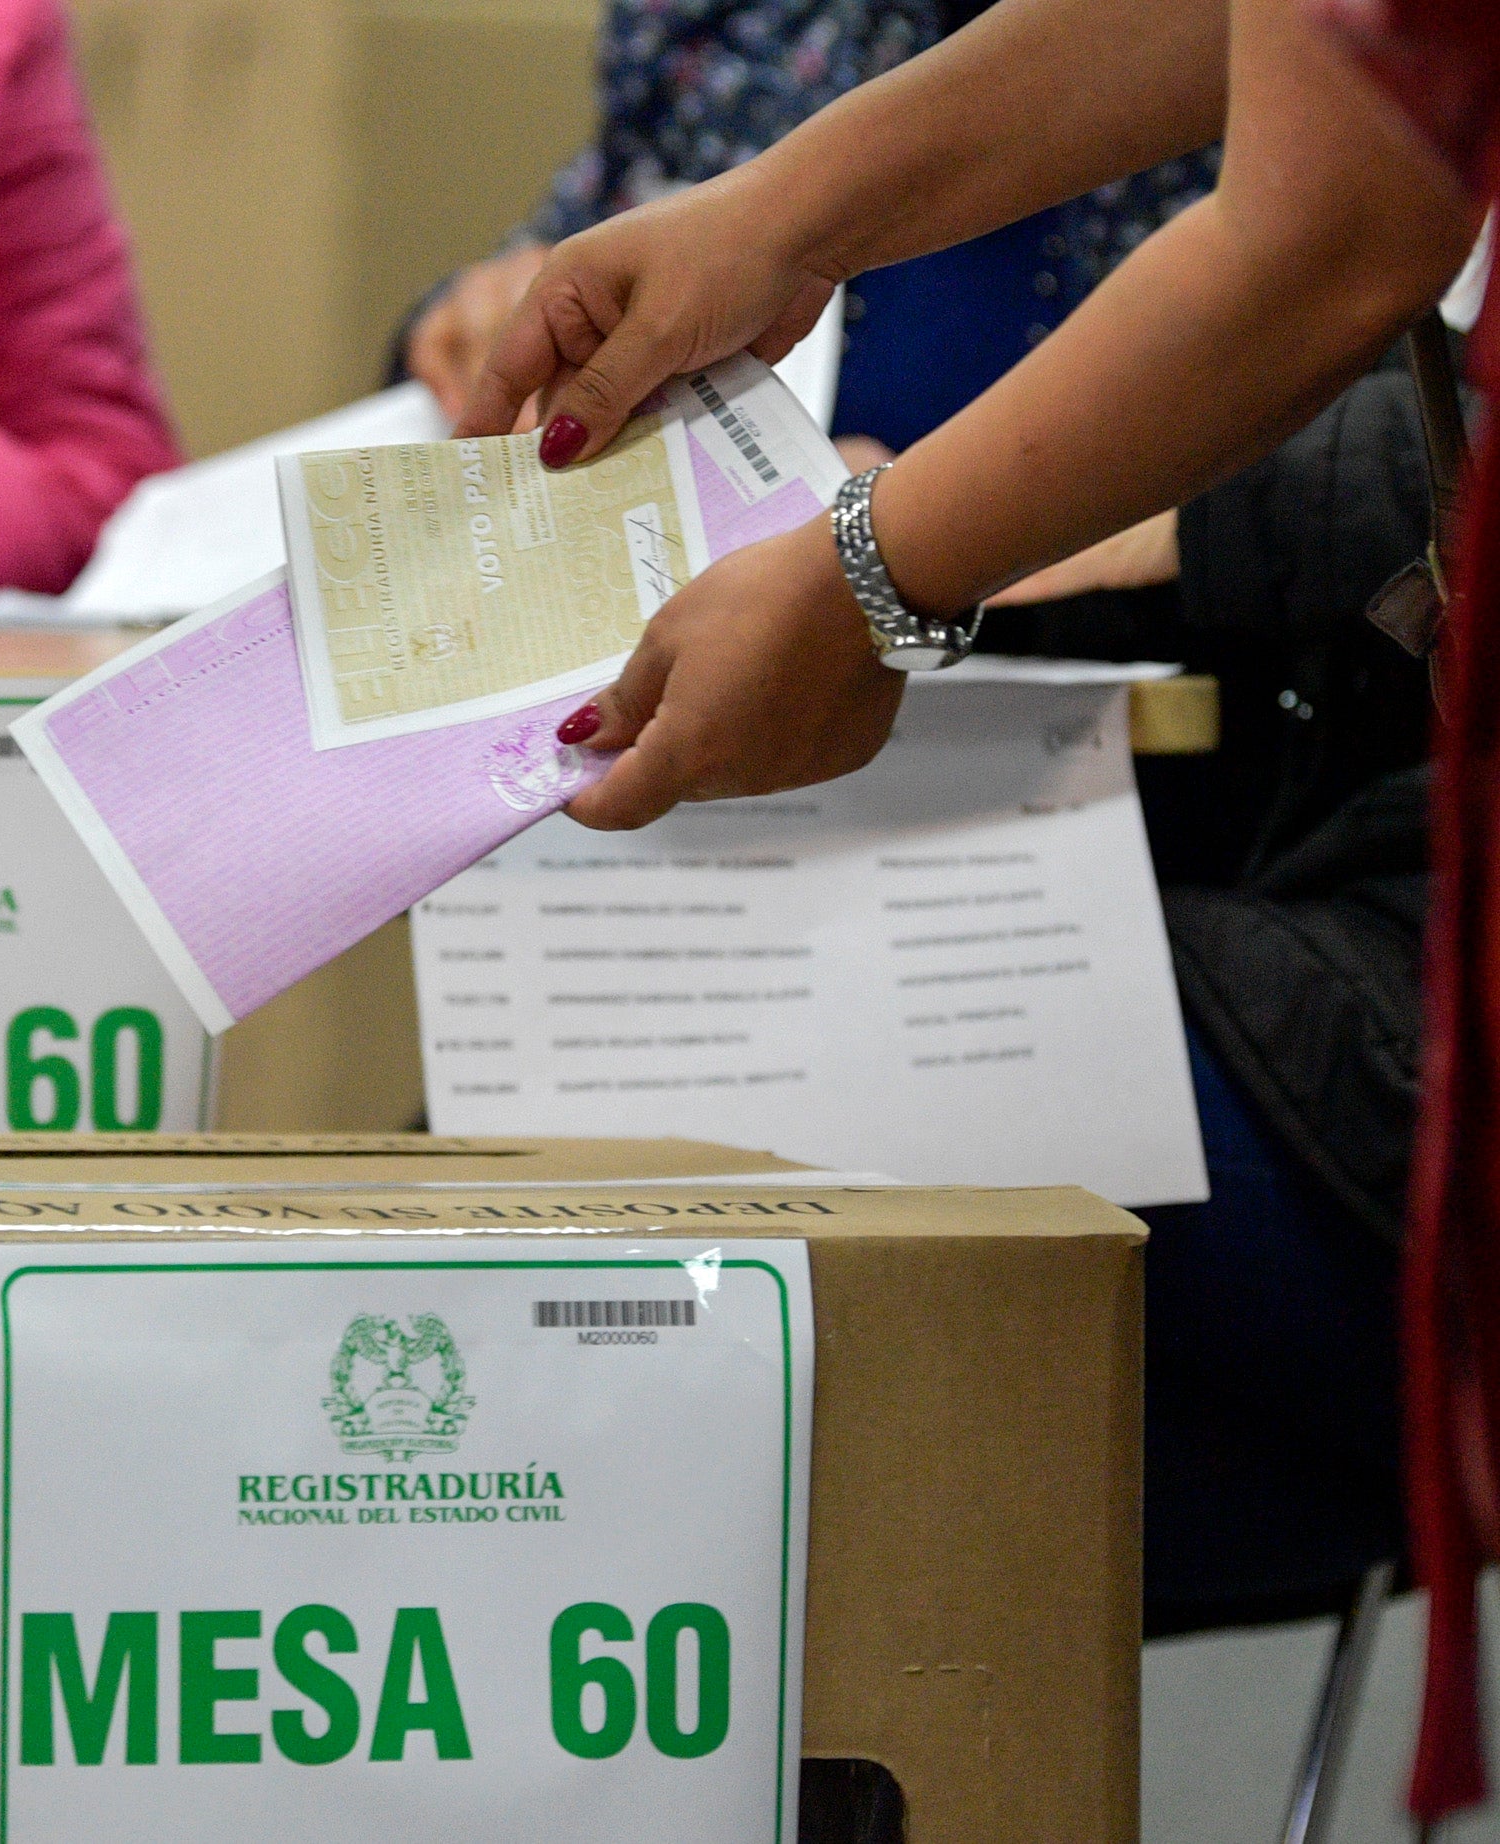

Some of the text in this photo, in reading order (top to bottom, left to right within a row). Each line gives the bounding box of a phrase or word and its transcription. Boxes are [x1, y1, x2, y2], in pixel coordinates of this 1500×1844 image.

[457, 438, 504, 594] VOTO PAR
[4, 1005, 165, 1134] 60
[112, 1203, 321, 1219] VOTO
[334, 1206, 436, 1219] SU
[455, 1201, 838, 1219] DEPOSITE
[577, 1331, 659, 1345] M2000060
[238, 1462, 564, 1504] REGISTRADURÍA
[238, 1506, 565, 1525] NACIONAL DEL ESTADO CIVIL
[18, 1602, 732, 1767] MESA 60
